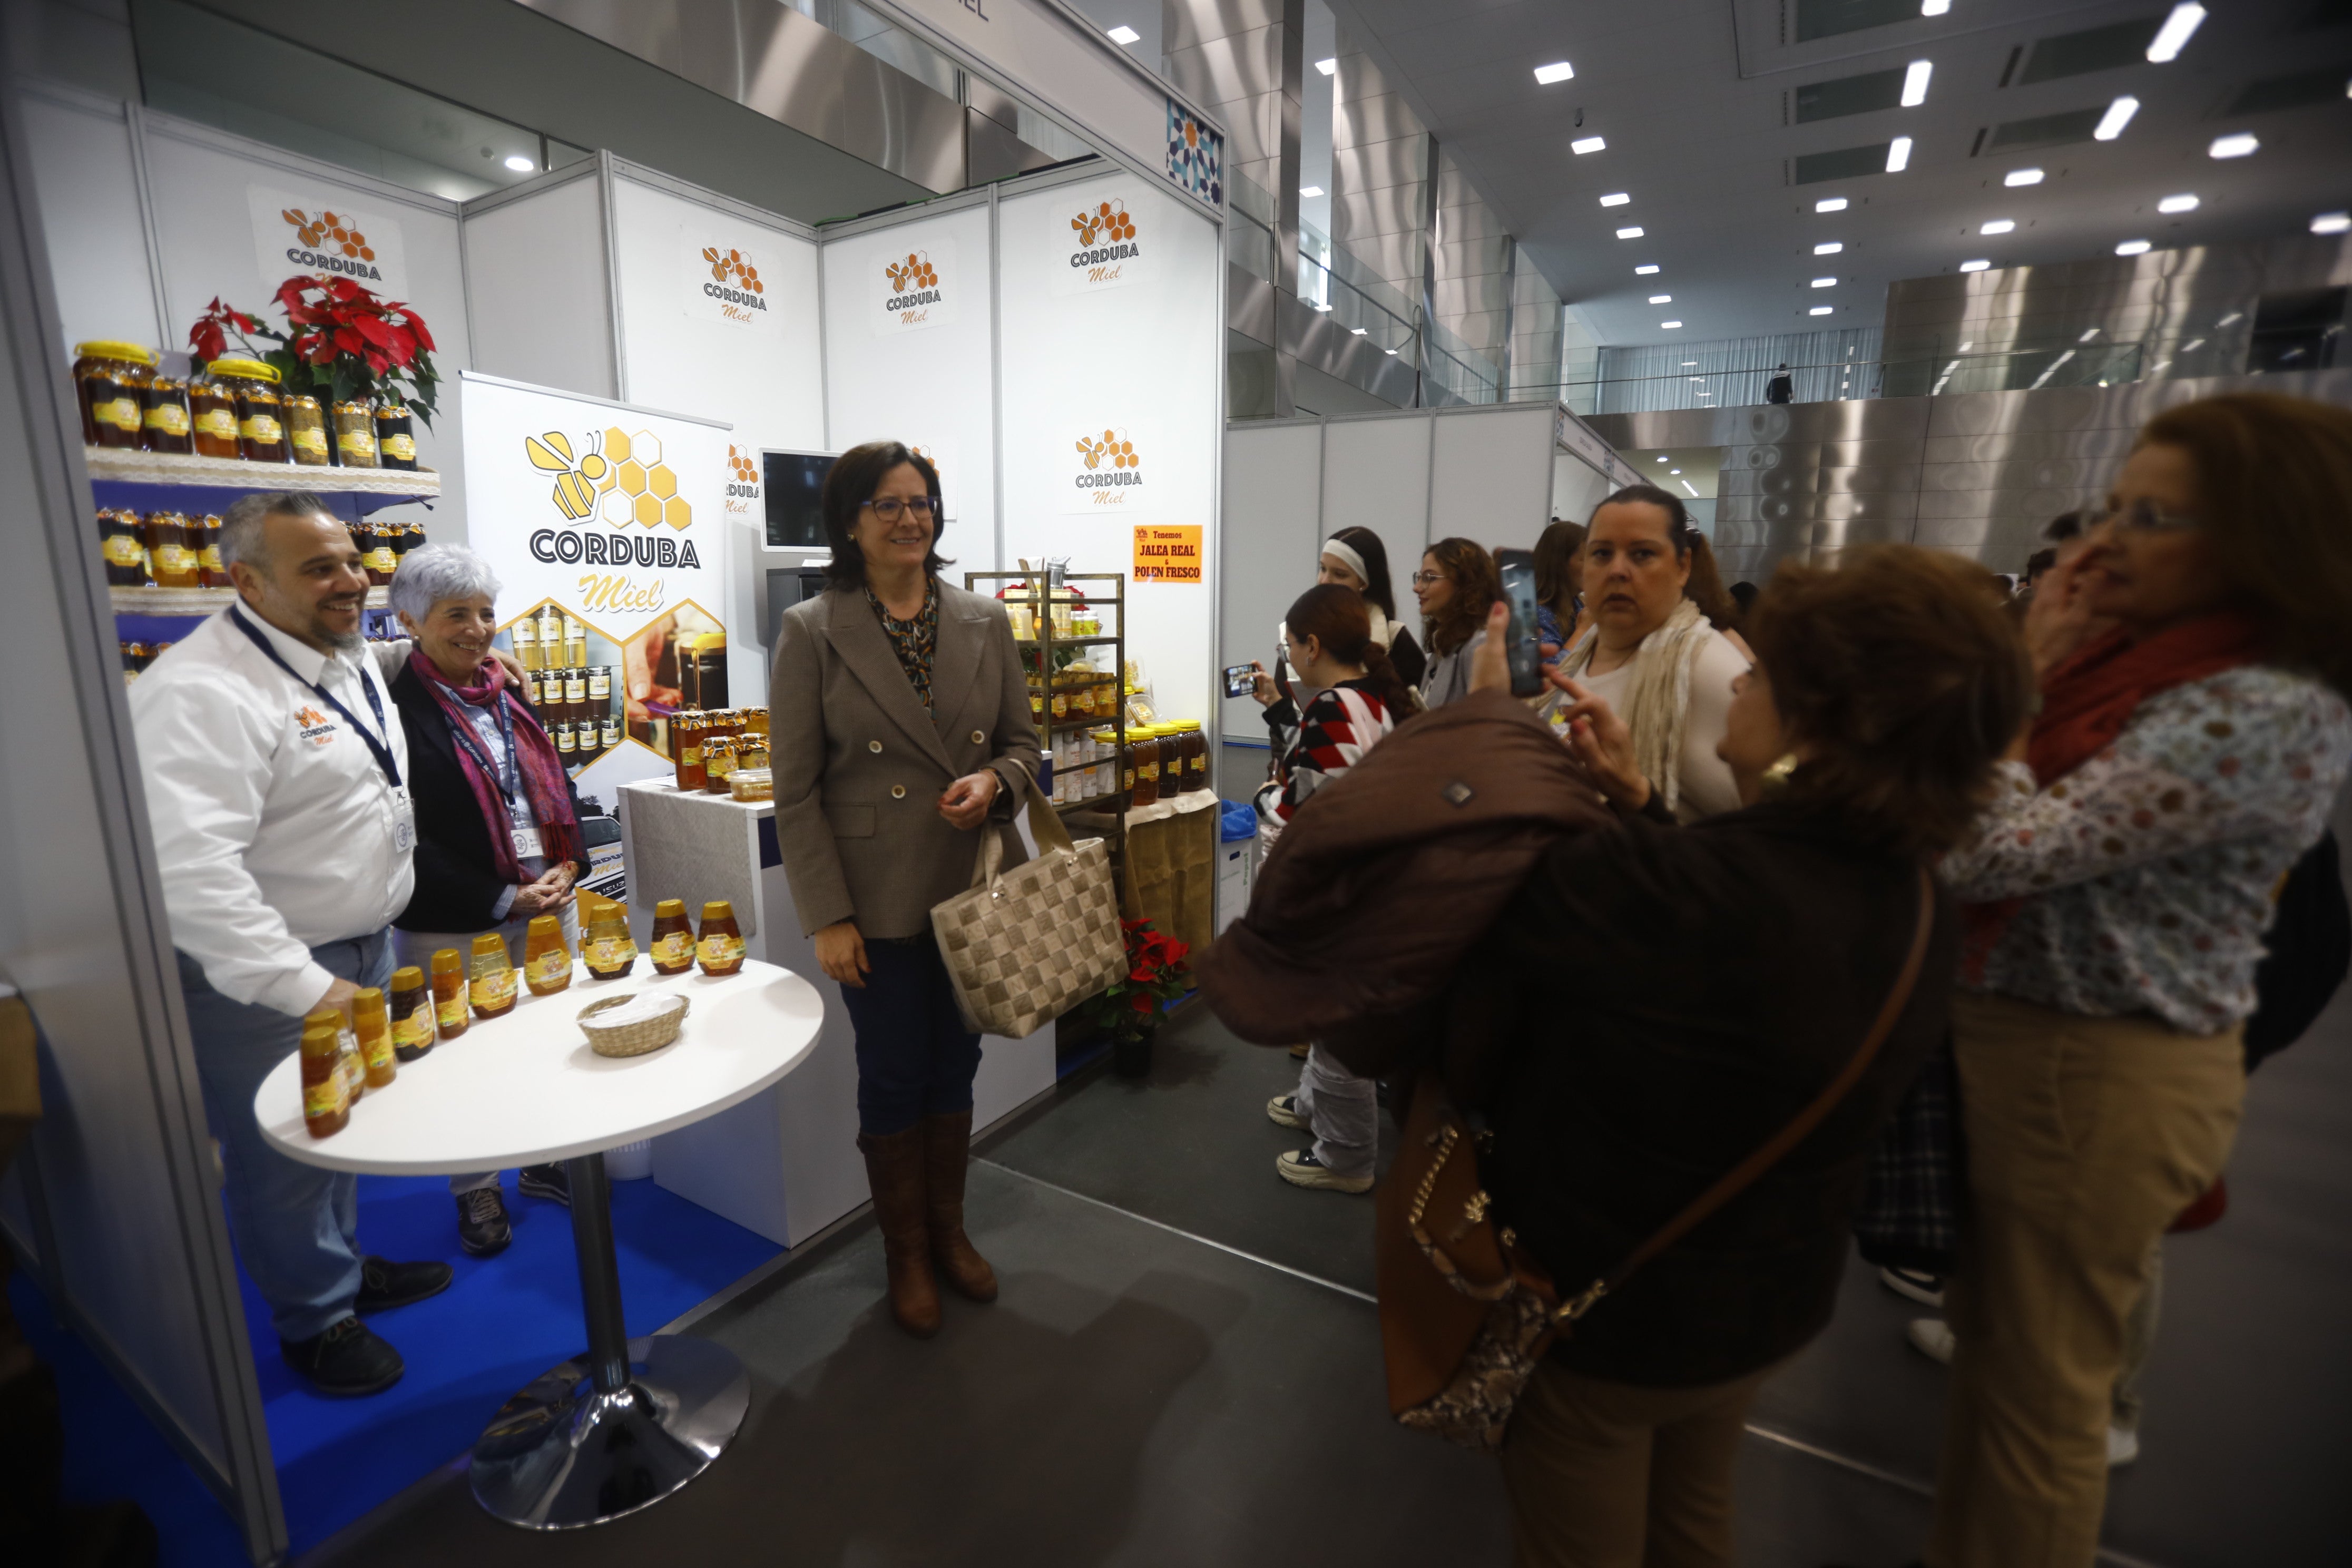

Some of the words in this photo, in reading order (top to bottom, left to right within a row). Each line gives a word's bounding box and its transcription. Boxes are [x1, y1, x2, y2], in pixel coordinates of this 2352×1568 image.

[287, 248, 382, 281] CORDUBA
[1071, 243, 1139, 268] CORDUBA
[1088, 264, 1121, 282] Miel
[703, 283, 767, 311] CORDUBA
[886, 289, 941, 311] CORDUBA
[721, 304, 752, 322] Miel
[900, 309, 927, 324] Miel
[1075, 472, 1142, 488] CORDUBA
[727, 484, 759, 498] DUBA
[1092, 491, 1125, 504] Miel
[529, 528, 701, 569] CORDUBA
[1140, 545, 1169, 556] JALEA
[1171, 545, 1195, 556] REAL
[1135, 566, 1163, 577] POLEN
[1166, 567, 1200, 577] FRESCO
[578, 574, 661, 609] Miel
[300, 724, 337, 739] CORDUBA
